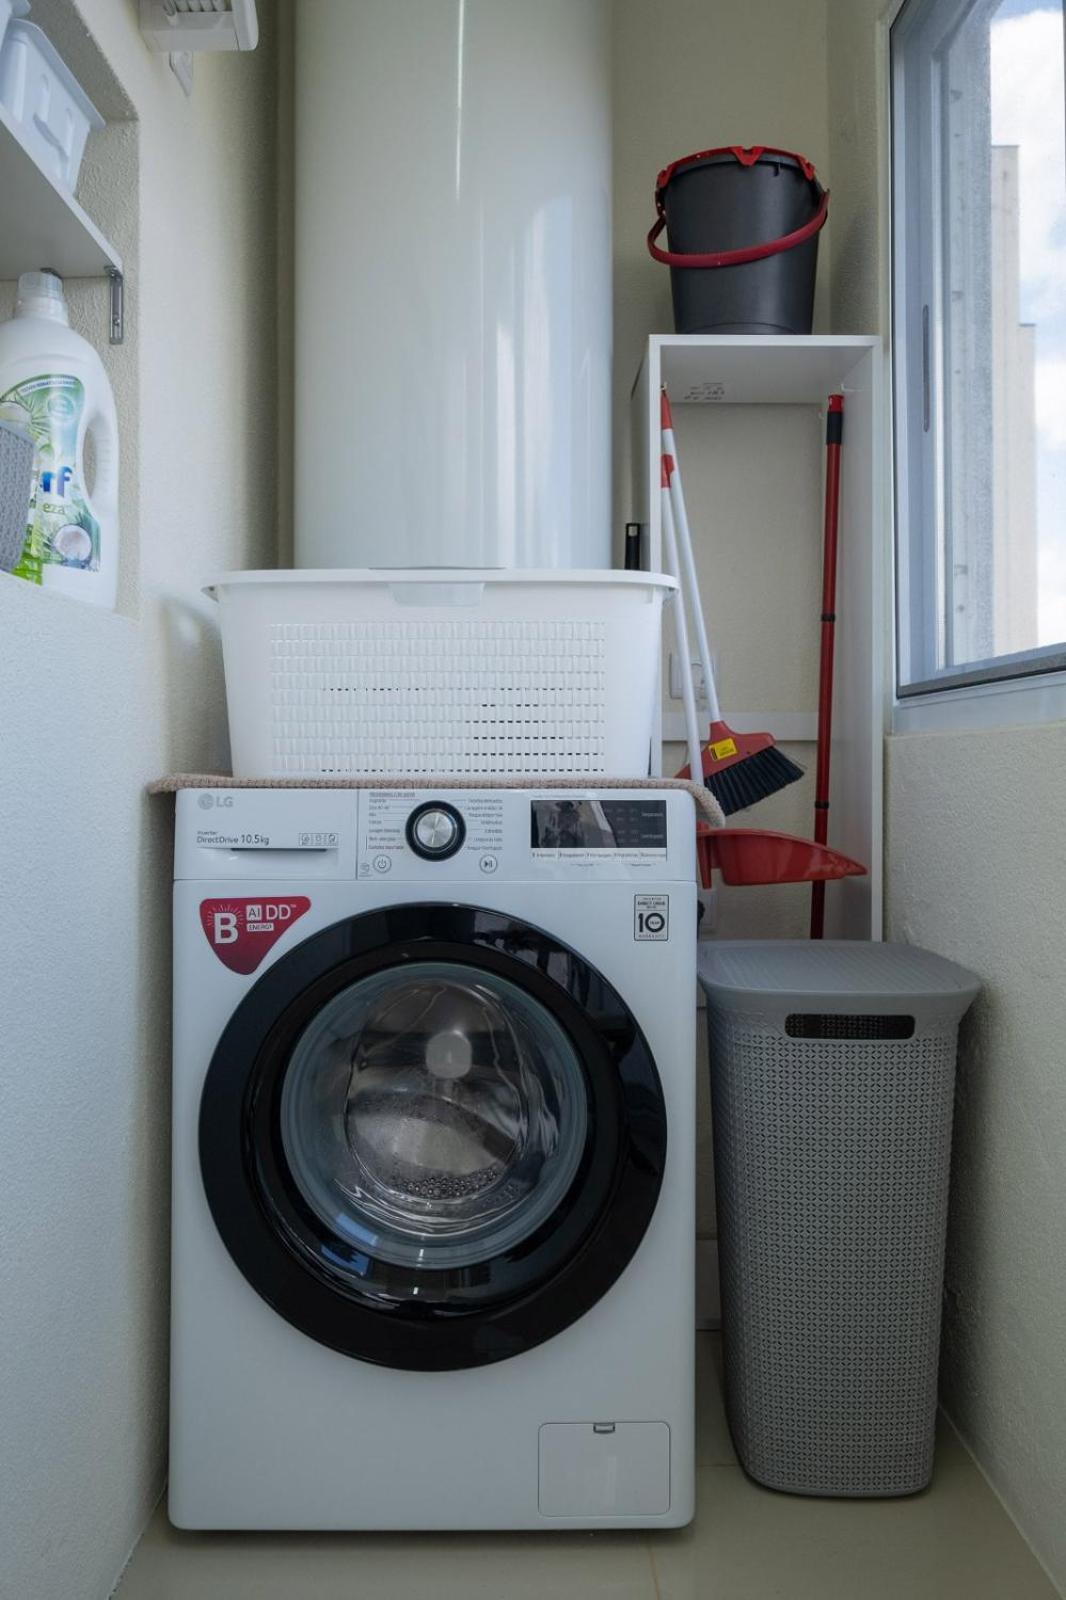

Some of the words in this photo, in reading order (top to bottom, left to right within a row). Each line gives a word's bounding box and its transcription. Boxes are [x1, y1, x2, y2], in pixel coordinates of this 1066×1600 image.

[216, 796, 234, 808] LG
[196, 836, 239, 844] DirectDrive
[213, 912, 239, 944] B
[638, 912, 666, 933] 10
